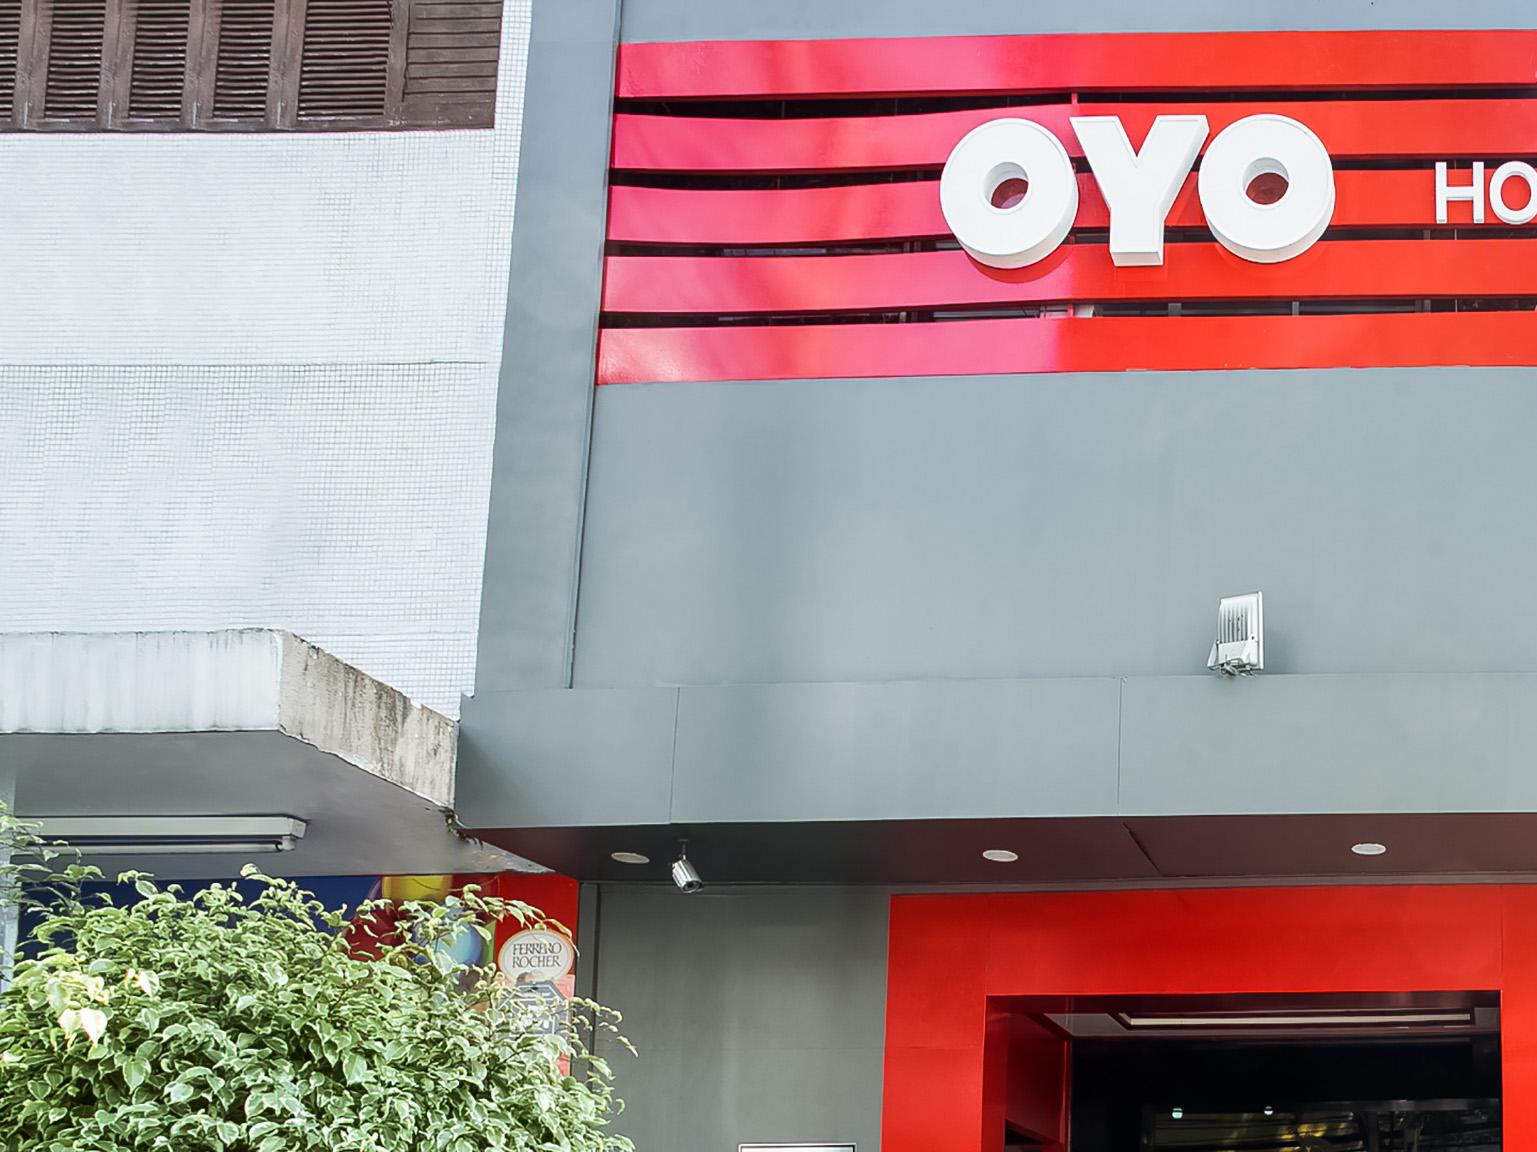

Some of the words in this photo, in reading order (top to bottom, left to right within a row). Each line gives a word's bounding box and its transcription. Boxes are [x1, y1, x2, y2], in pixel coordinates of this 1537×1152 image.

[940, 113, 1336, 269] OYO
[512, 942, 562, 955] FERRERO
[512, 956, 561, 968] ROCHER
